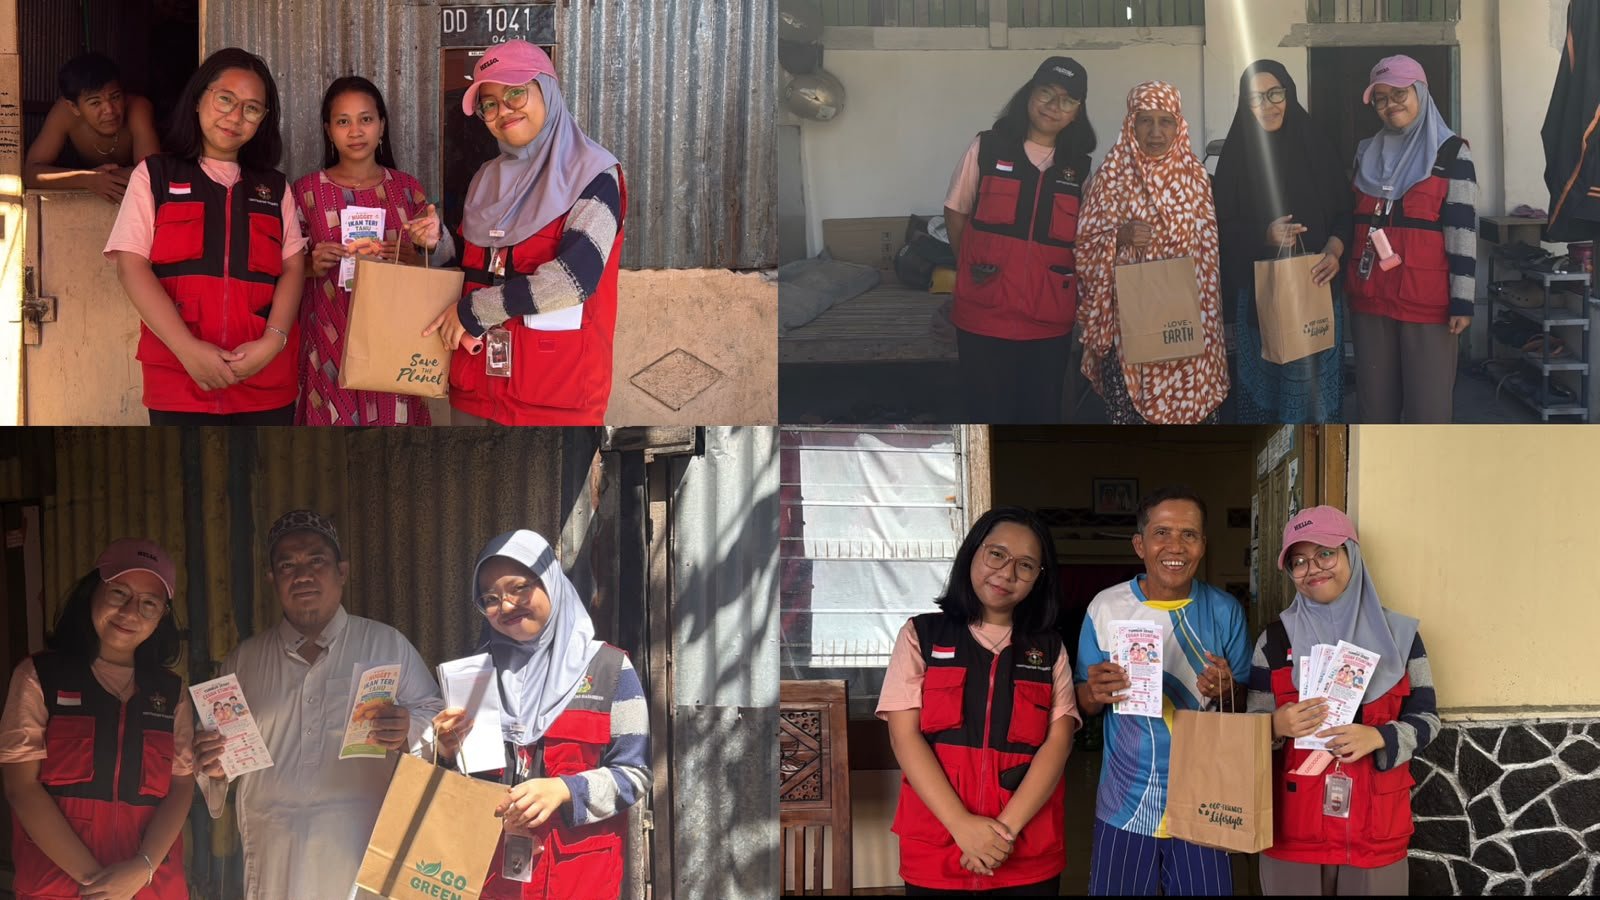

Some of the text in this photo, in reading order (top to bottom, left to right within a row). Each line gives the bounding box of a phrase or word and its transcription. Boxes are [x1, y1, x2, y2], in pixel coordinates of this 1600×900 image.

[443, 8, 530, 33] DD 1041
[1168, 320, 1189, 328] LOVE
[1163, 327, 1194, 344] EARTH
[410, 353, 438, 367] Save
[396, 367, 443, 385] Planet
[1209, 811, 1243, 830] Lifestyle
[410, 876, 462, 900] GREEN
[441, 870, 467, 891] GO
